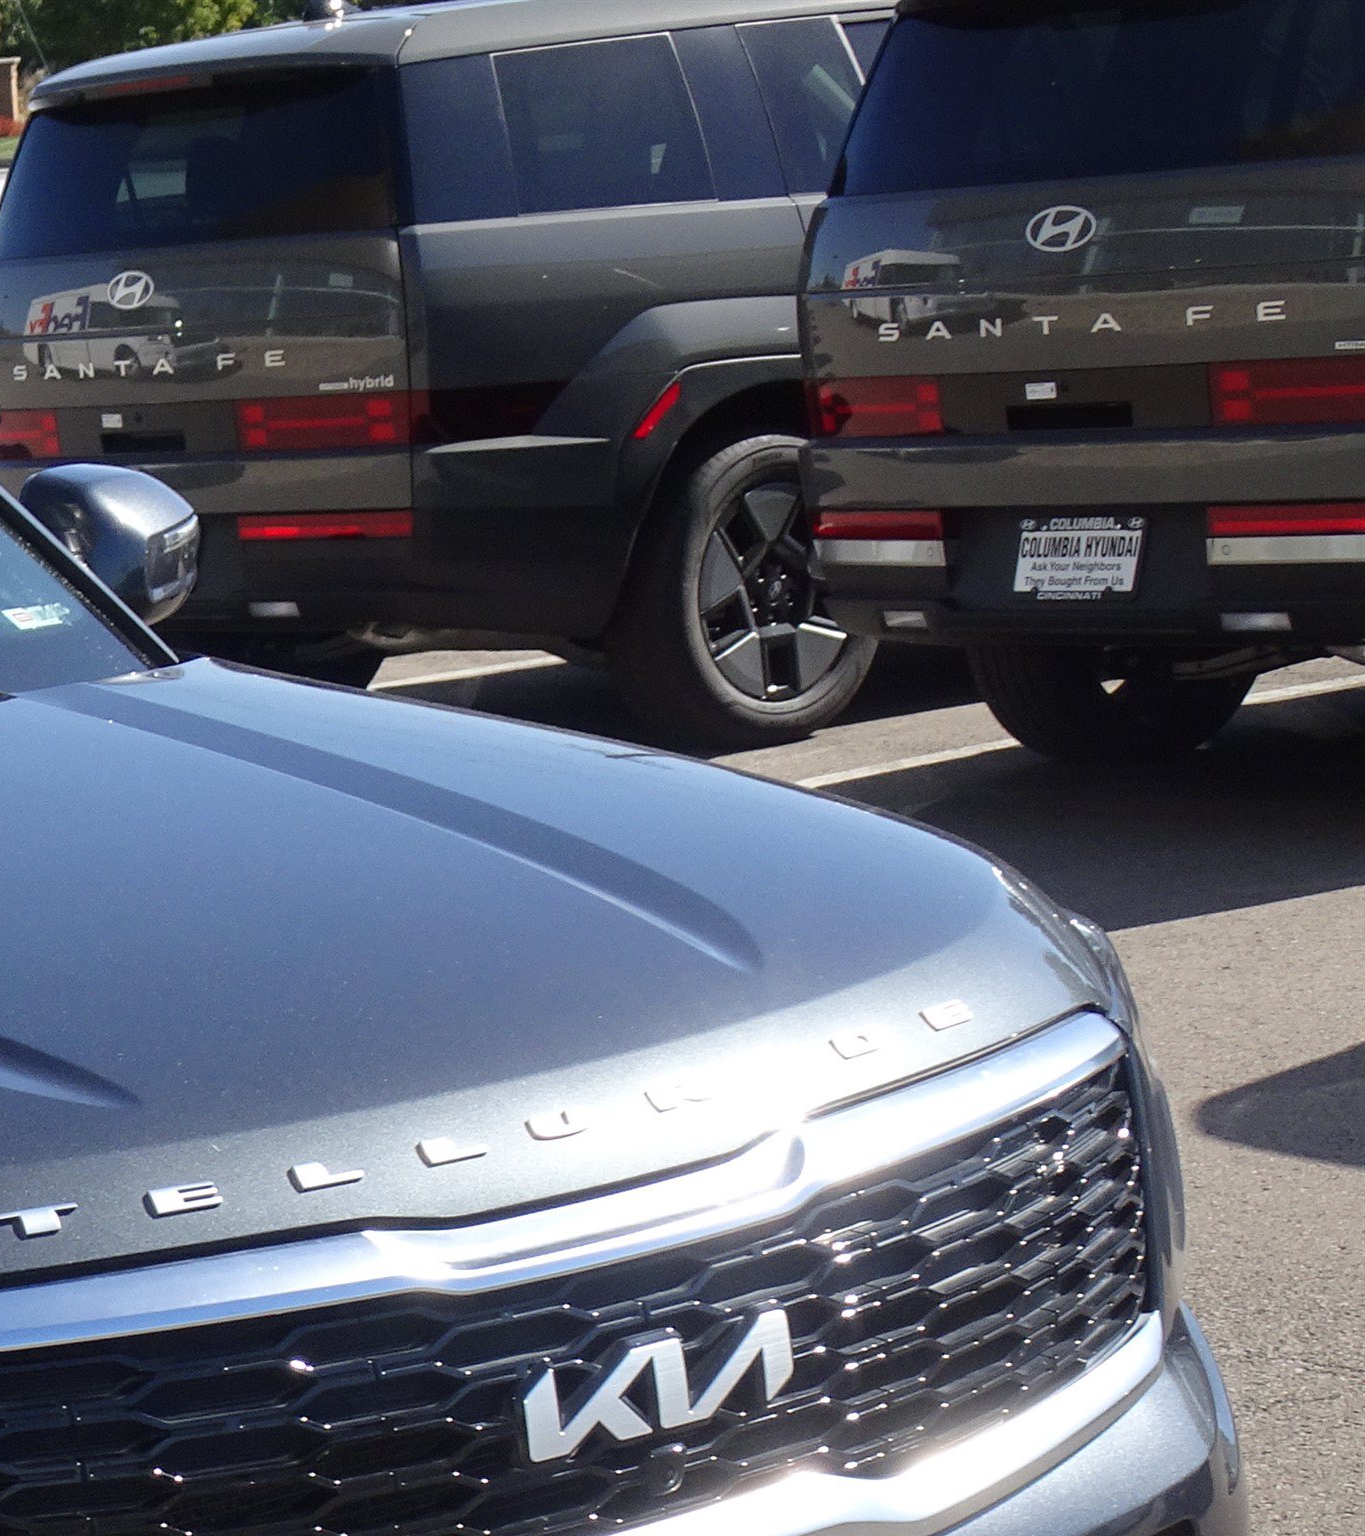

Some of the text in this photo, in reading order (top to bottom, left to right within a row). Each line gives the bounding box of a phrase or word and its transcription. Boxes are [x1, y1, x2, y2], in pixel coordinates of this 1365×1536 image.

[878, 301, 1287, 342] SANTA FE
[12, 350, 285, 381] SANTA FE
[349, 374, 394, 391] hybrid
[1049, 517, 1115, 530] COLUMBIA
[1021, 535, 1139, 558] COLUMBIA HYUNDAI
[1030, 561, 1121, 573] Ask Your Neighbors
[1024, 576, 1124, 588] They Bought From Us
[1036, 592, 1102, 600] CINCINNATI
